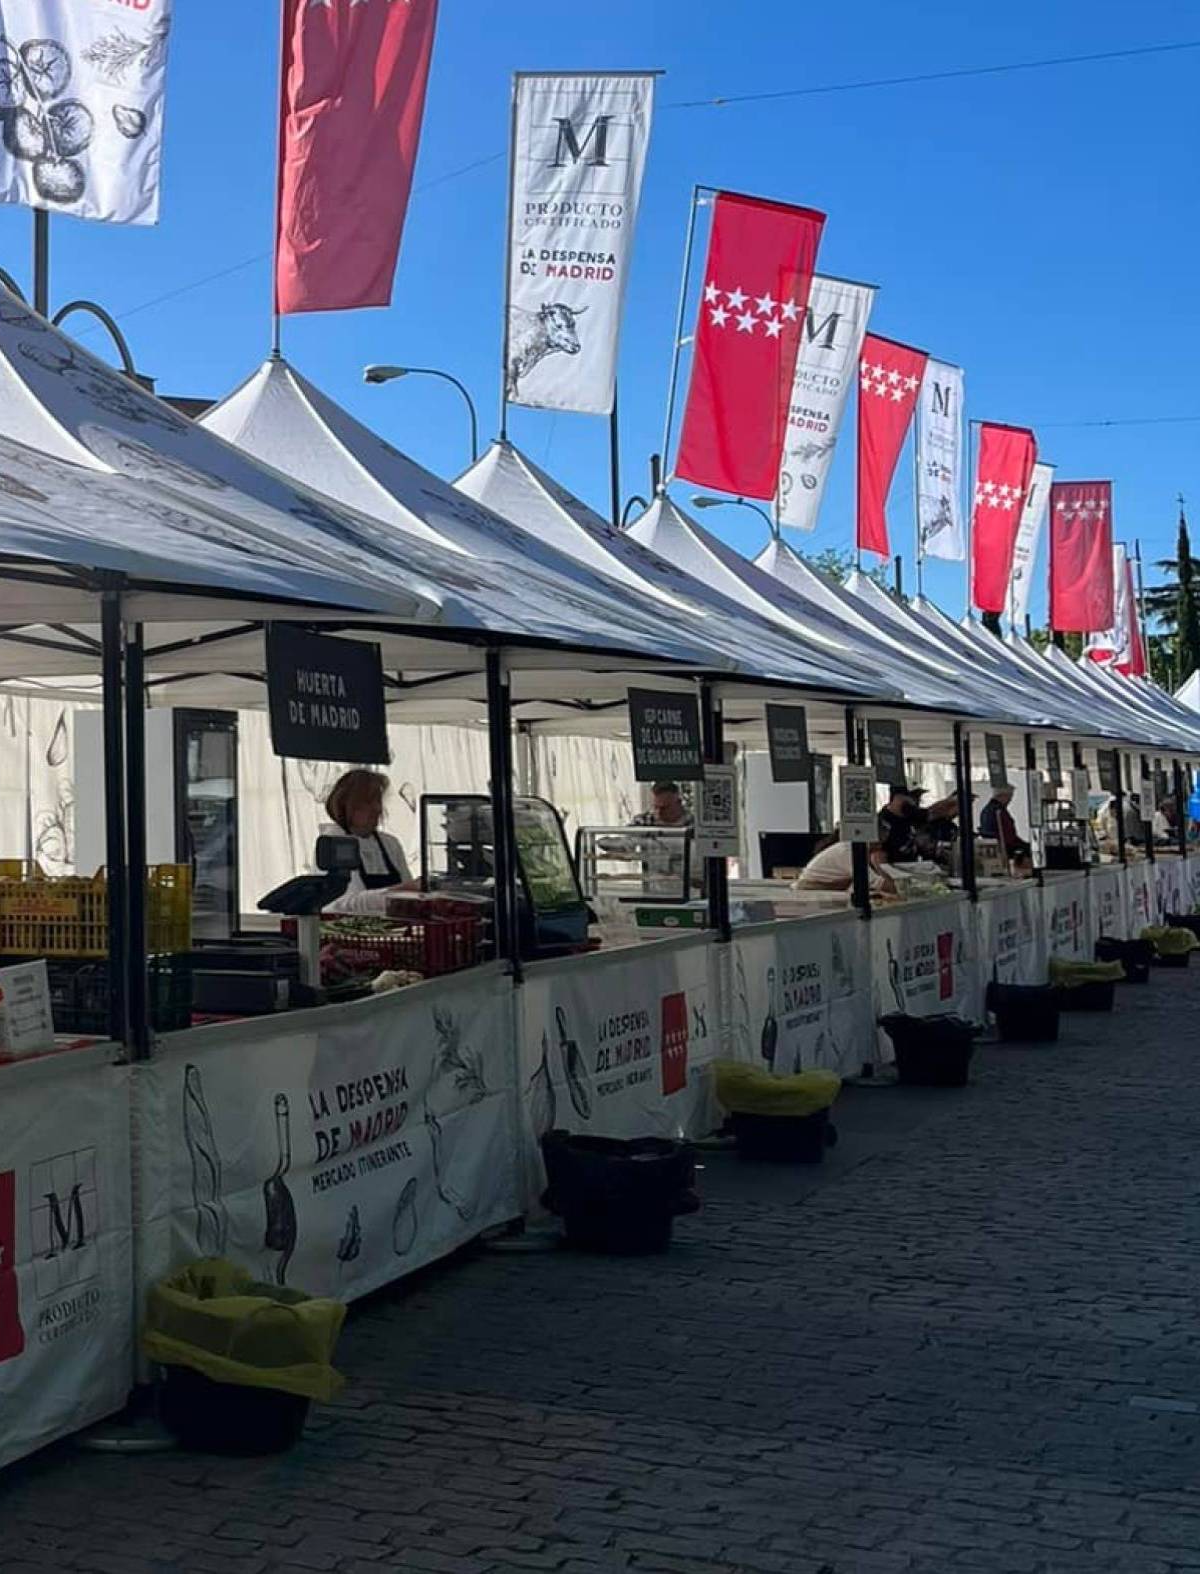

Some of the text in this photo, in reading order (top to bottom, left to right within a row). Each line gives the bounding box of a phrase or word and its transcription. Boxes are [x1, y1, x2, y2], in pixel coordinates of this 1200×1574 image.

[547, 115, 617, 168] M
[525, 202, 622, 217] PRODUCTO
[540, 250, 616, 265] DESPENSA
[545, 265, 615, 281] MADRID
[789, 417, 828, 433] ADRID
[297, 668, 346, 698] HUERTA
[288, 700, 361, 730] DE MADRID
[308, 1065, 409, 1120] LA DESPENSA
[315, 1126, 341, 1165] DE
[312, 1141, 413, 1194] MERCADO ITINERANTE
[43, 1182, 87, 1260] M
